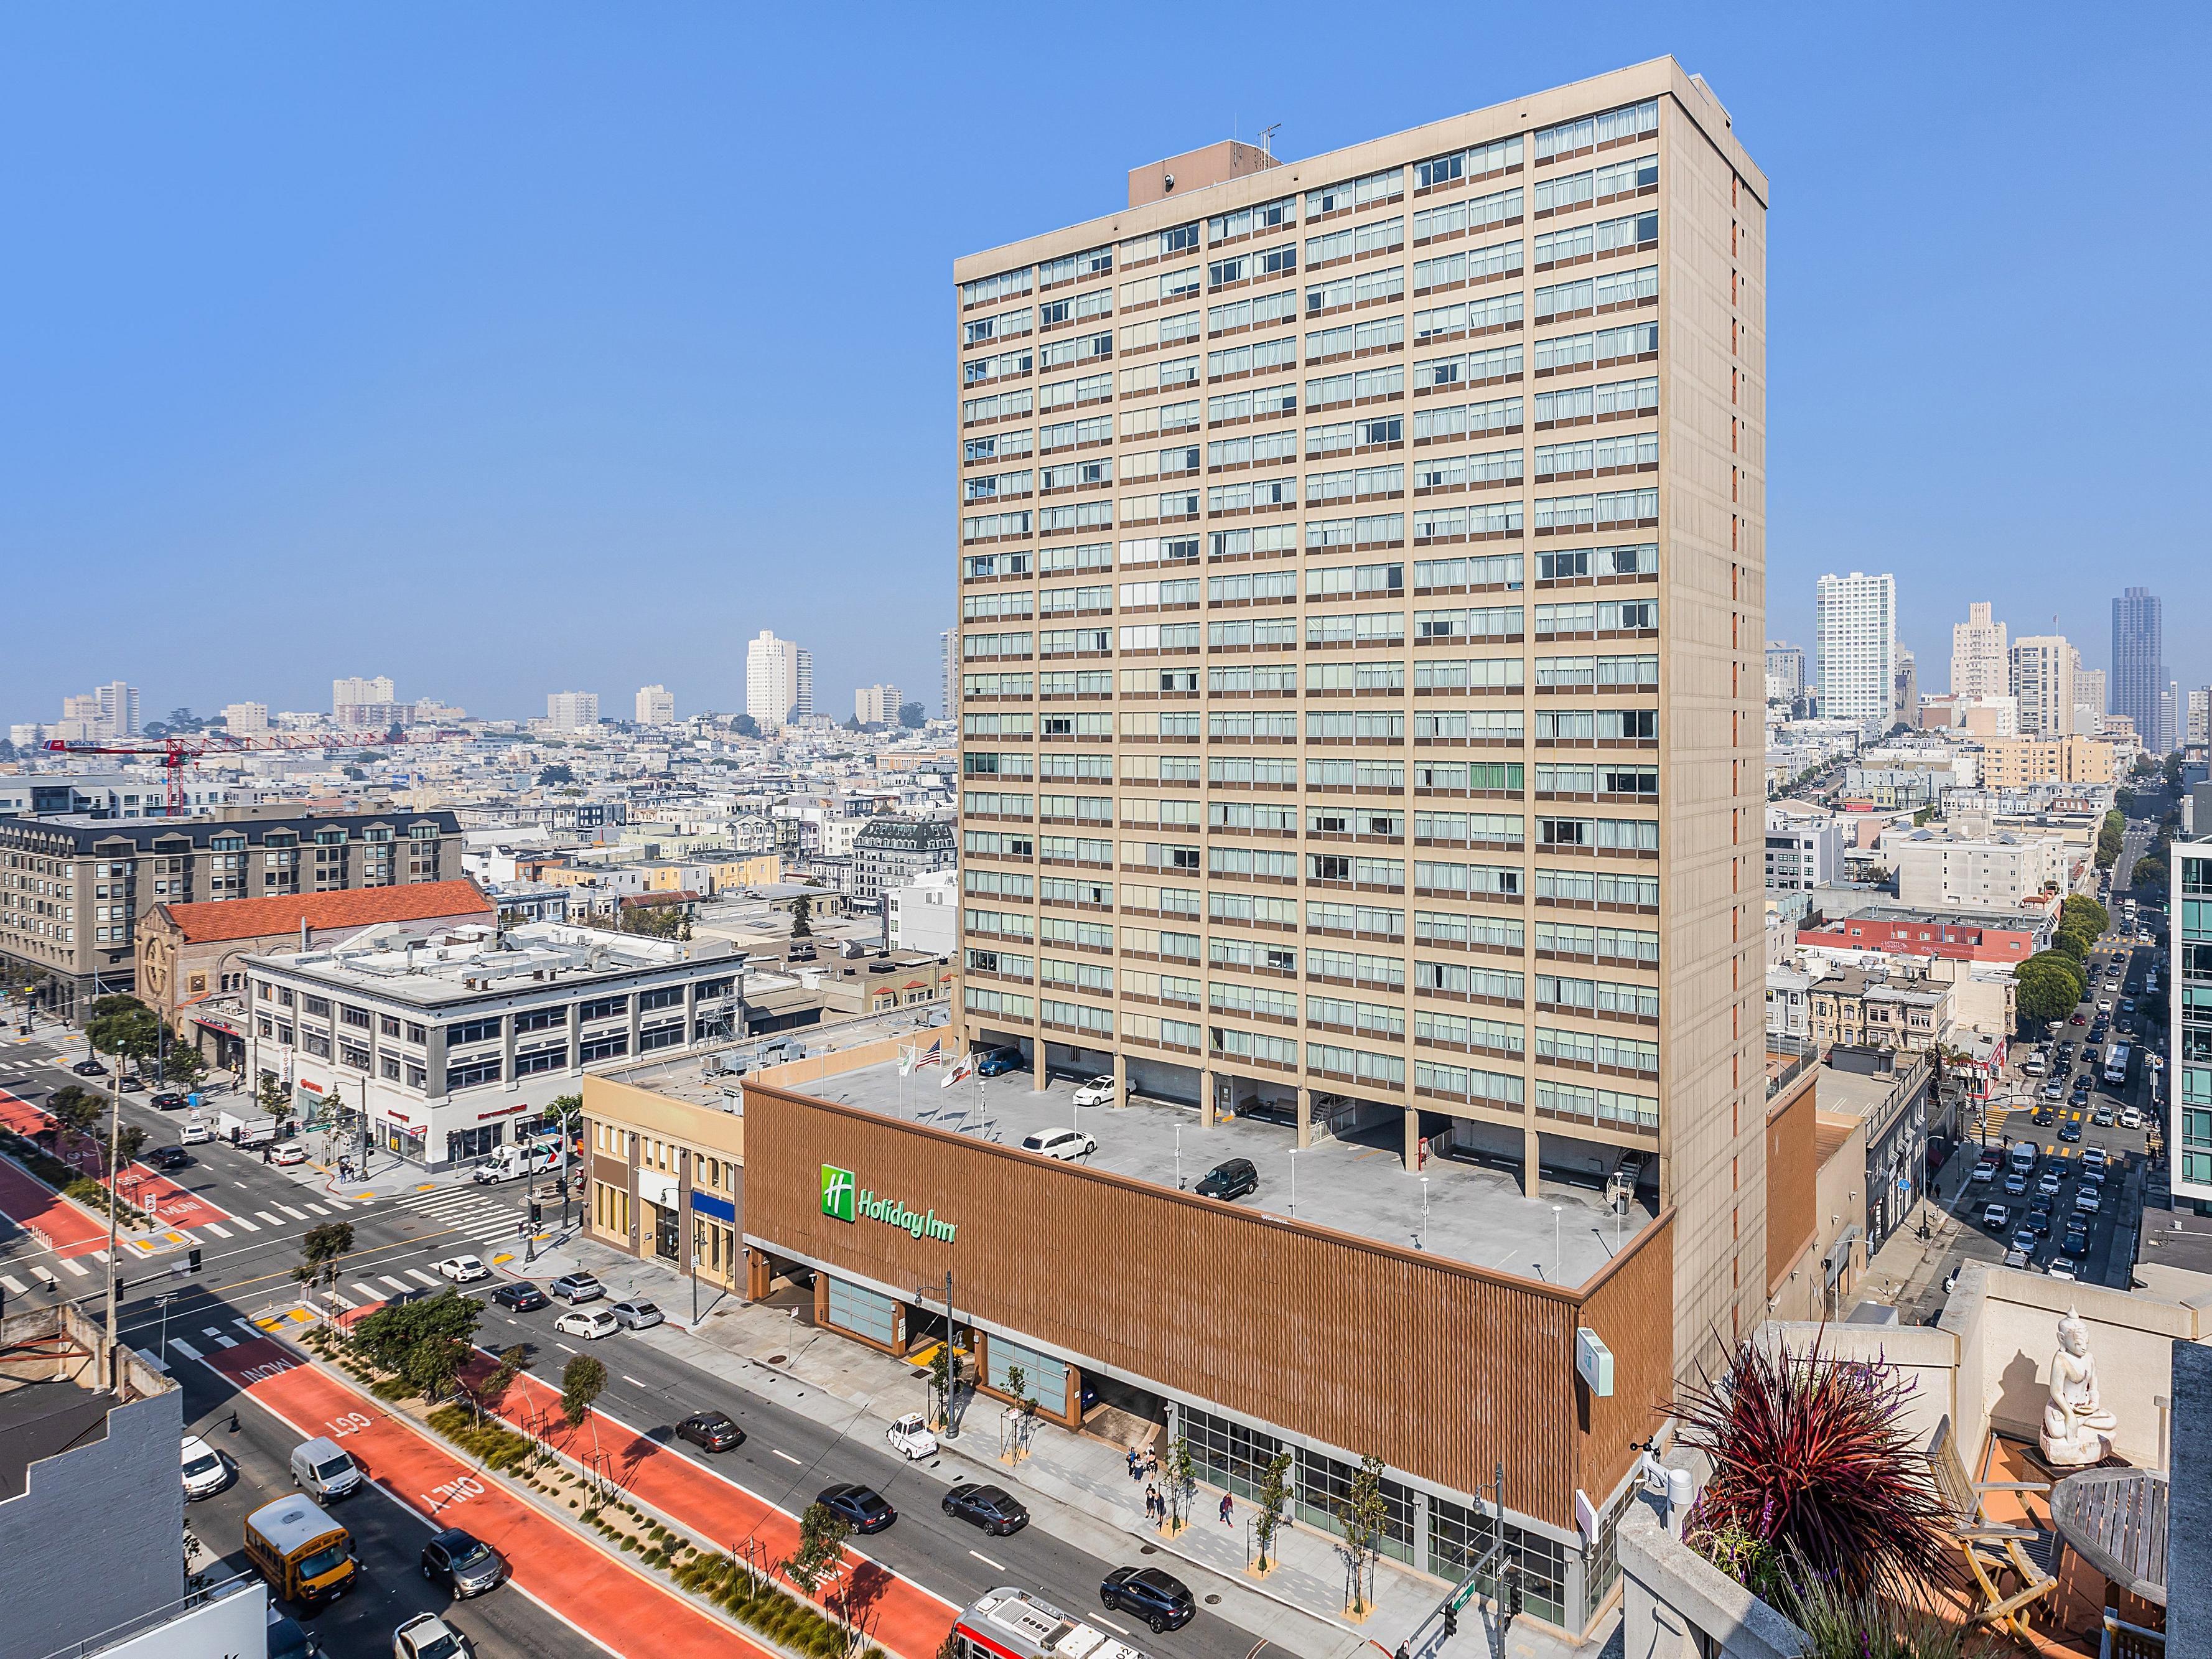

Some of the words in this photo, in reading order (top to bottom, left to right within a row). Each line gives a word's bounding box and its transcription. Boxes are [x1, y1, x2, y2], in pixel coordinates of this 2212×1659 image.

[159, 1202, 202, 1217] MUNI
[858, 1189, 926, 1238] Holiday
[925, 1208, 956, 1243] Inn
[240, 1358, 298, 1384] MUNI
[325, 1412, 371, 1438] GGT
[420, 1476, 485, 1514] ONLY
[1460, 1593, 1468, 1605] Pine
